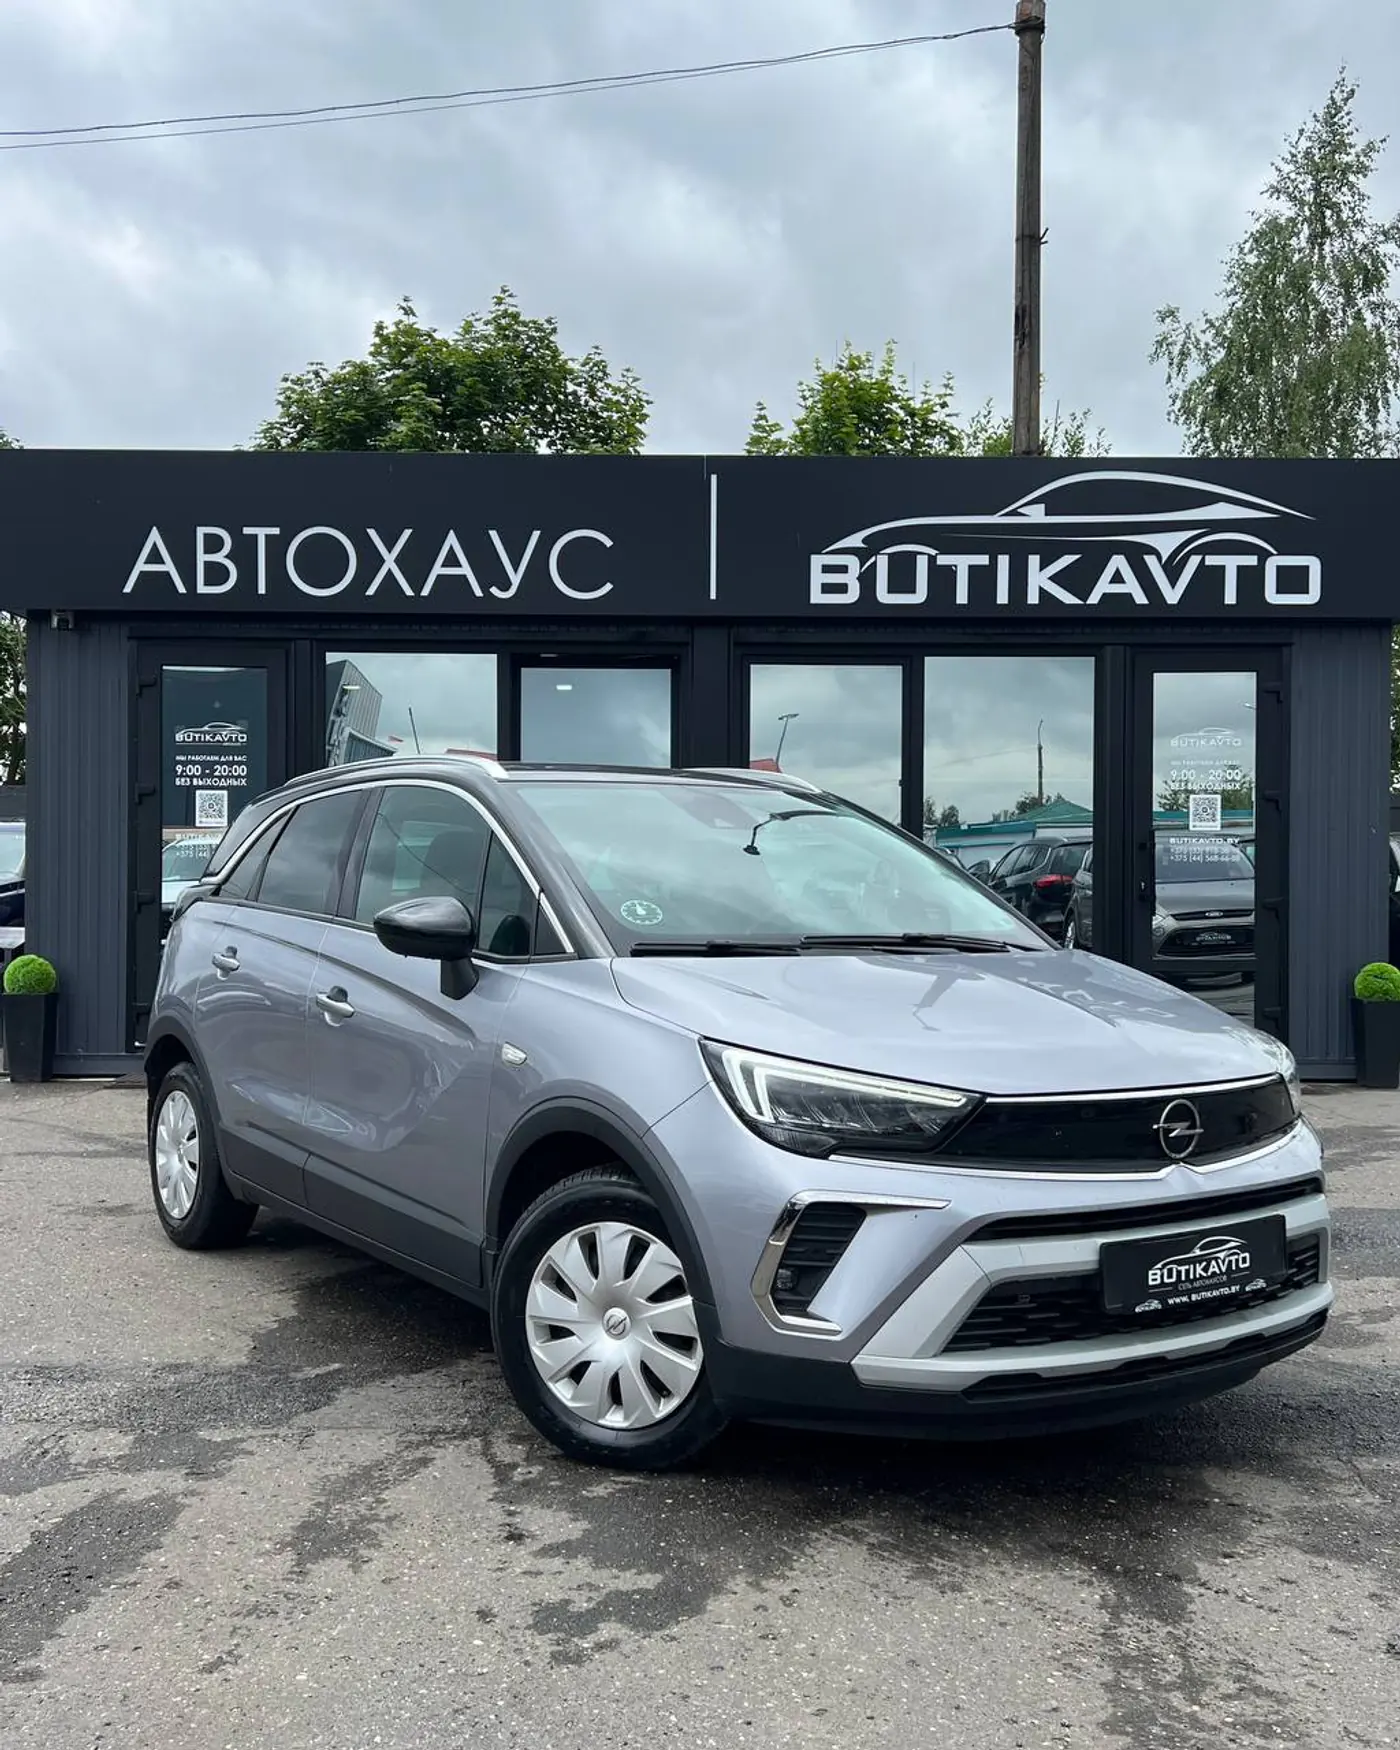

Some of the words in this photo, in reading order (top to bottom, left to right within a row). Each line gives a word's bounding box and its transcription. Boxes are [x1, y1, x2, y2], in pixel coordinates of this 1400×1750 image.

[122, 525, 615, 600] АВТОХАУС
[809, 553, 1322, 606] BUTIKAVTO
[175, 733, 248, 742] BUTIKAVTO
[175, 764, 201, 776] 9:00
[213, 764, 248, 776] 20:00
[175, 778, 190, 786] БЕЗ
[192, 778, 248, 786] ВЫХОДНЫХ
[1169, 837, 1240, 845] BUTIKAVTO.BY
[1148, 1252, 1250, 1286] BUTIKAVTO
